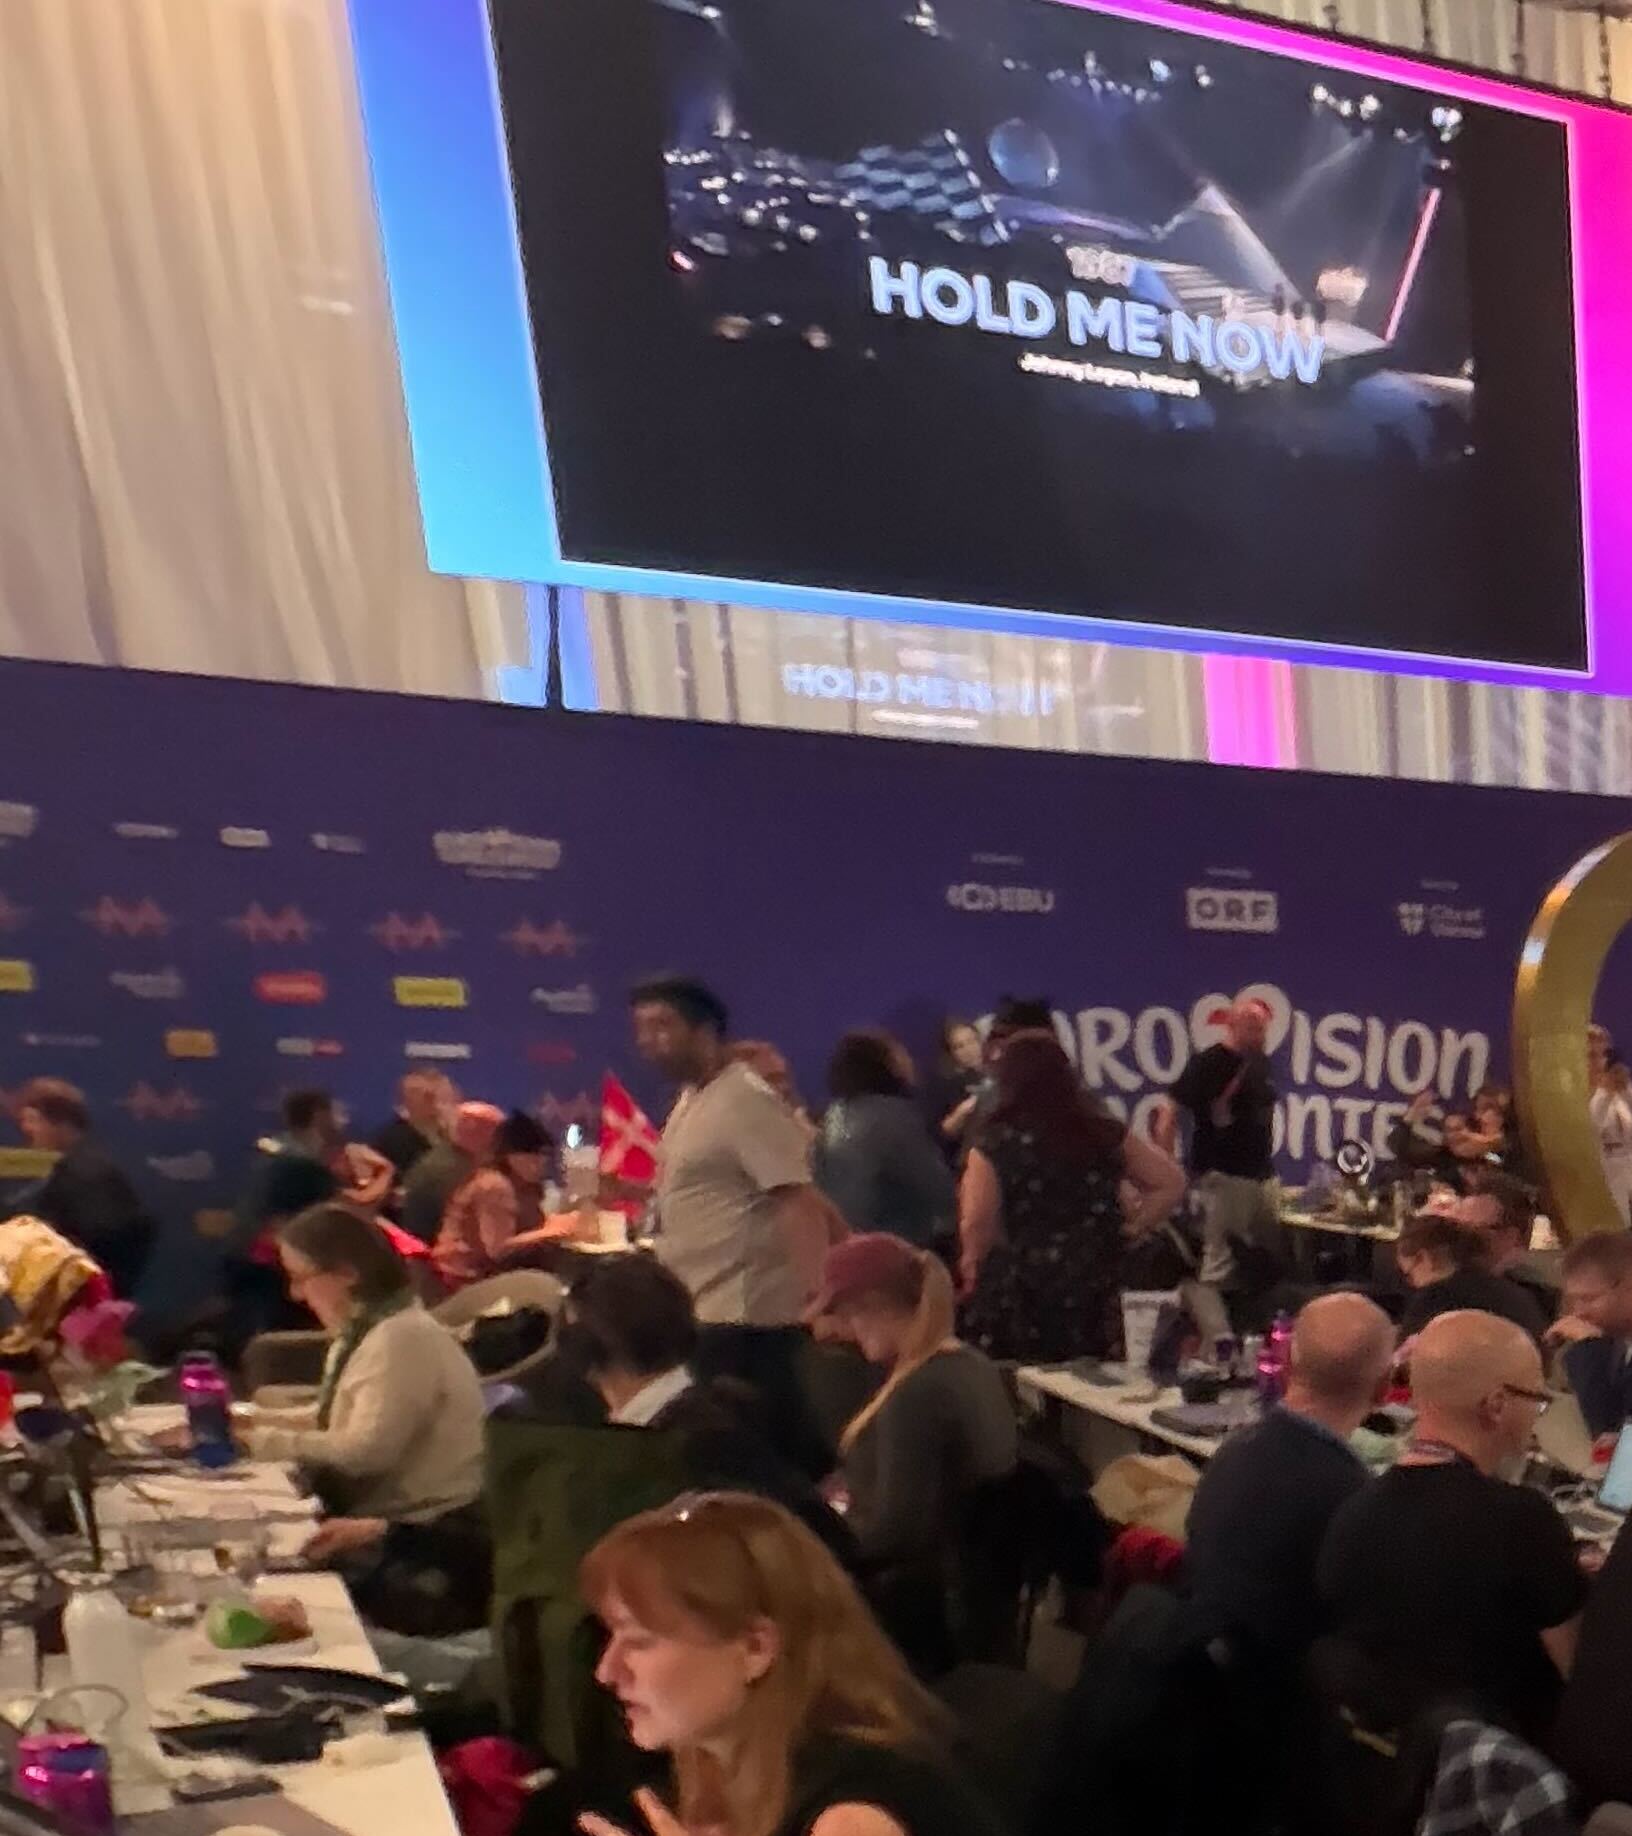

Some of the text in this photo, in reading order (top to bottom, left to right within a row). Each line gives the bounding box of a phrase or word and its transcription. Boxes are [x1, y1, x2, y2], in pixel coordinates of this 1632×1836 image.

[869, 255, 1326, 385] HOLD ME NOW
